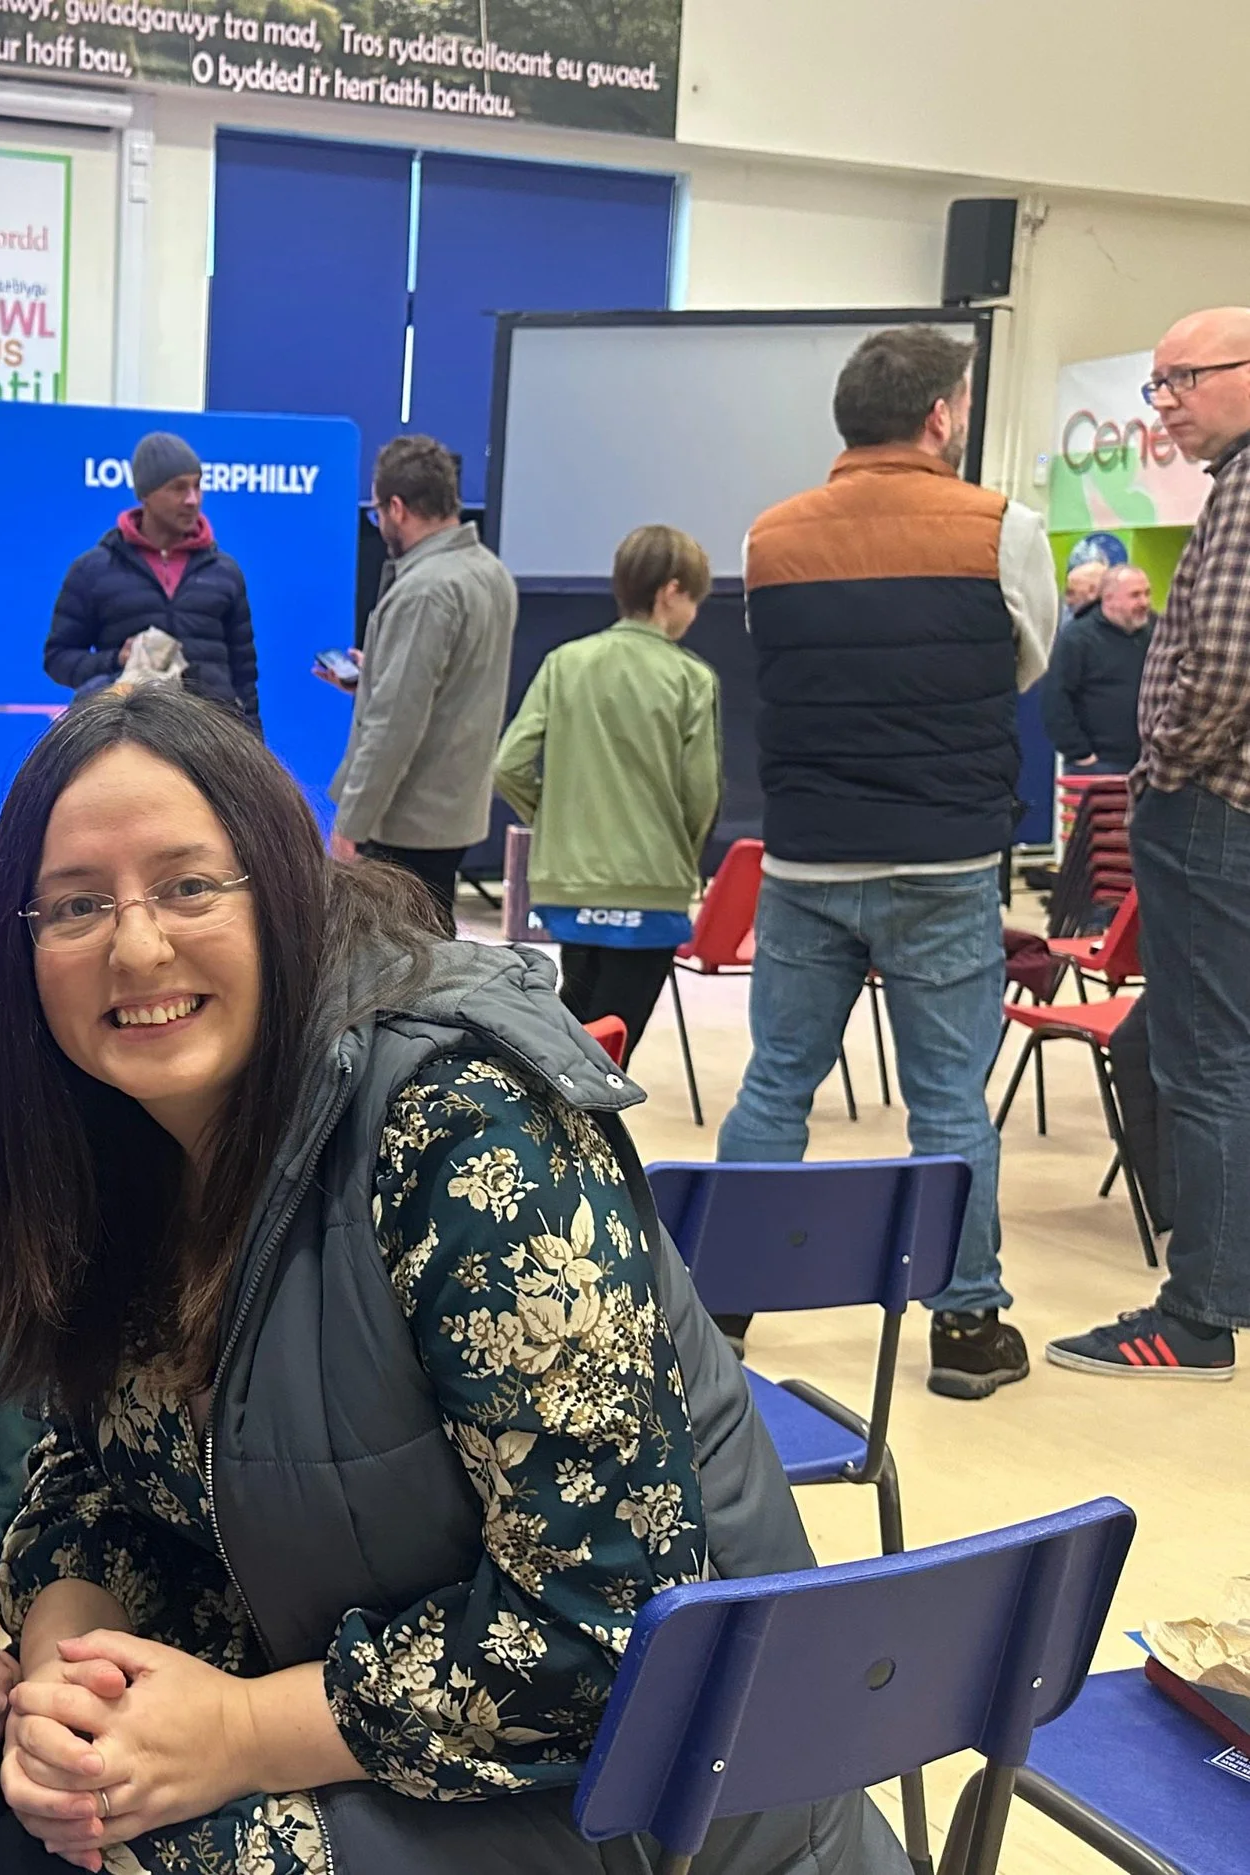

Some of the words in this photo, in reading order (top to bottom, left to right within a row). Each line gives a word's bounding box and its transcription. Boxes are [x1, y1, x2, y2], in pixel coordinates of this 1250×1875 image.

[26, 31, 74, 69] hoff
[78, 36, 134, 78] bau,
[65, 0, 218, 41] gwladgarwyr
[223, 12, 258, 42] tra
[263, 18, 323, 53] mad,
[191, 51, 215, 84] O
[218, 54, 305, 94] bydded
[433, 79, 516, 118] barhau.
[340, 23, 384, 58] Tros
[388, 34, 458, 67] ryddid
[461, 42, 553, 78] collasant
[556, 57, 584, 82] eu
[587, 62, 661, 92] gwaed.
[1062, 408, 1196, 475] Cene
[199, 462, 319, 494] ERPHILLY
